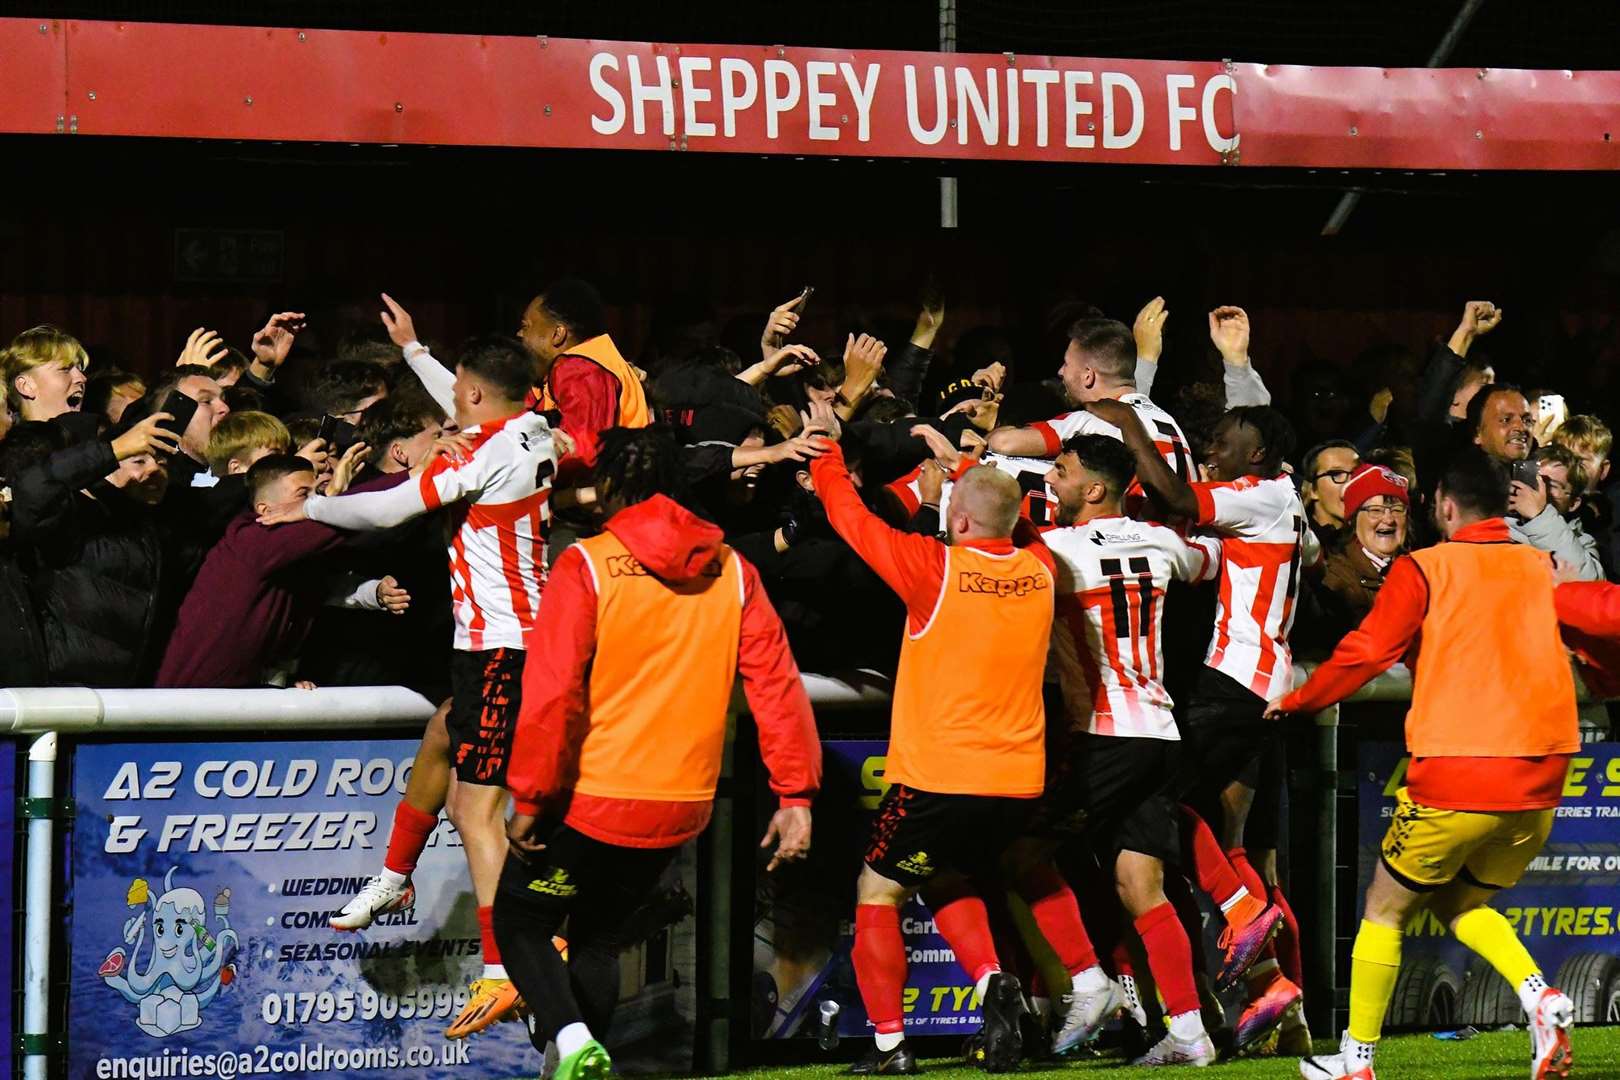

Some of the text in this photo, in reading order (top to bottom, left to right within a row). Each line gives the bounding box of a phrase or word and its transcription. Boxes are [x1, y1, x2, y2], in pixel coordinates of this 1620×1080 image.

[589, 52, 1241, 154] SHEPPEY UNITED FC
[959, 571, 1048, 598] Kappa
[1100, 556, 1152, 638] 11
[103, 761, 184, 800] A2
[194, 760, 319, 799] COLD
[104, 815, 148, 854] &
[156, 811, 378, 853] FREEZER
[1566, 856, 1601, 872] FOR
[281, 908, 419, 929] COMCIAL
[278, 938, 481, 962] SEASONAL EVENTS
[262, 985, 472, 1025] 01795 905999
[930, 1017, 958, 1025] TYRES
[96, 1038, 471, 1080] enquiries@a2coldrooms.co.uk
